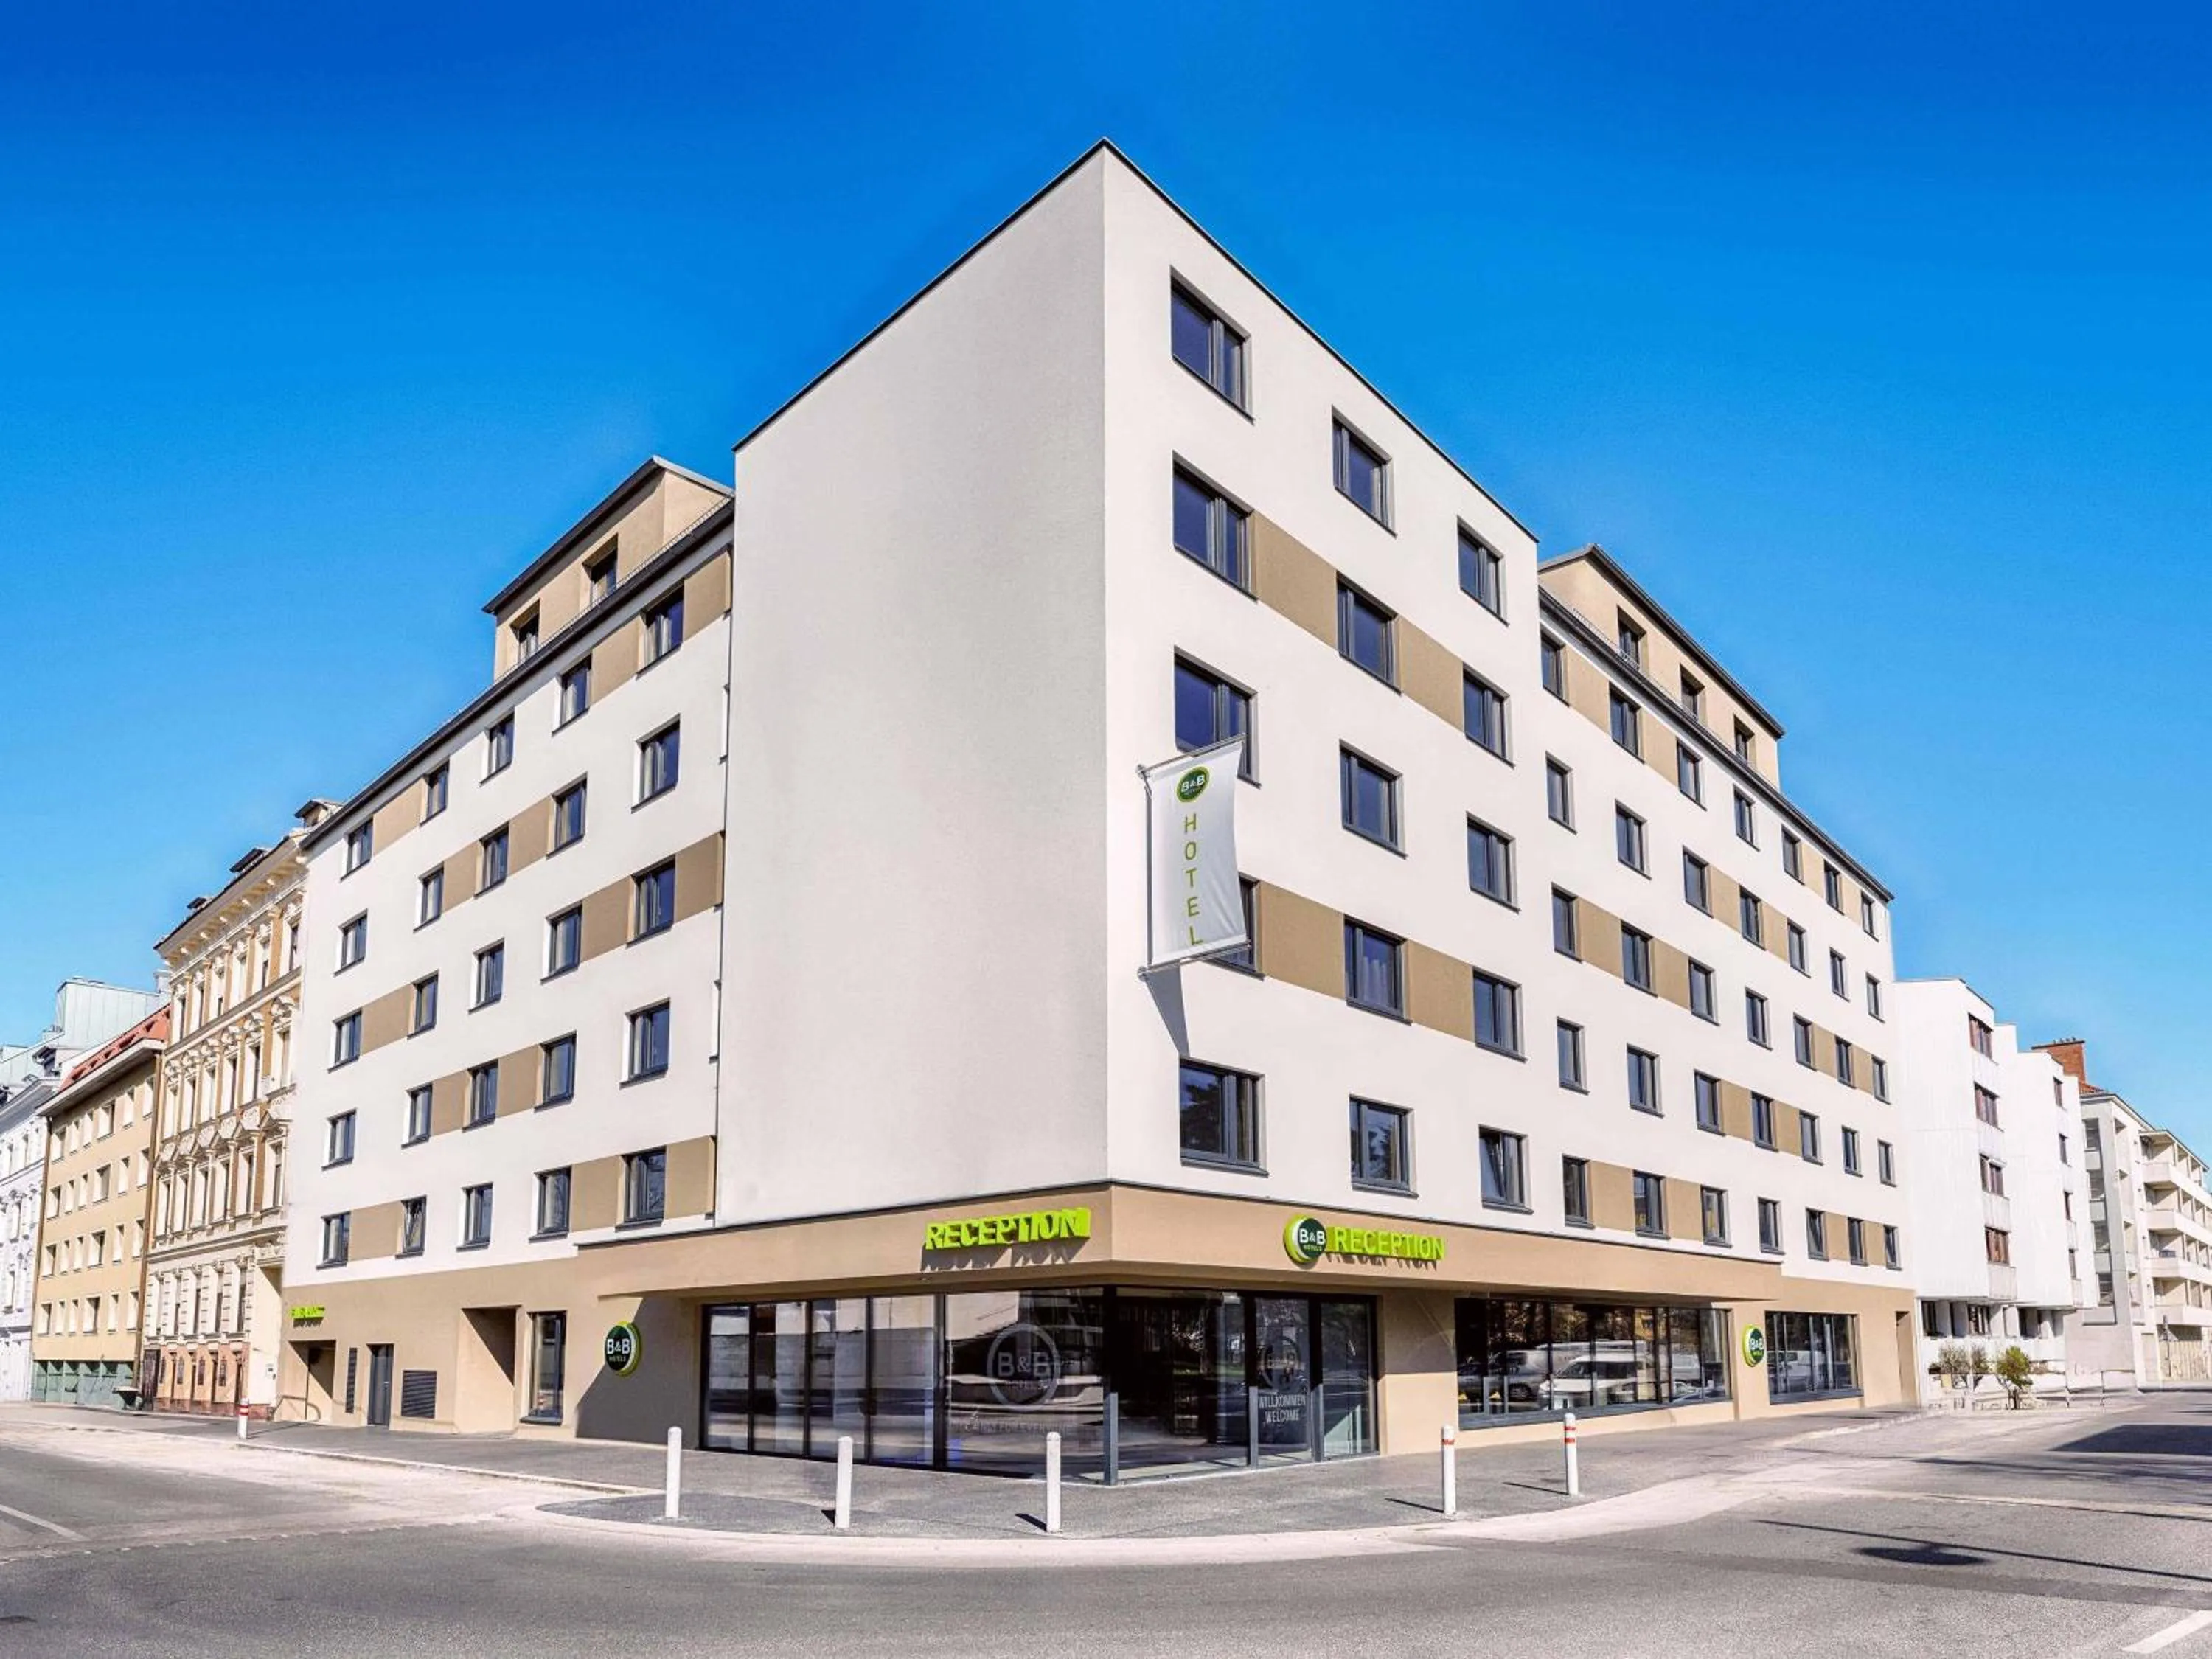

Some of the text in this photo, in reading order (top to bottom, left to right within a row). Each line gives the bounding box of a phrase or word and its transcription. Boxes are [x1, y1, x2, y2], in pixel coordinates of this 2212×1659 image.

[1184, 812, 1204, 946] HOTEL
[925, 1208, 1091, 1250] RECEPTION
[1299, 1228, 1325, 1245] B&B
[1333, 1226, 1444, 1260] RECEPTION
[607, 1338, 630, 1354] B&B
[998, 1352, 1051, 1377] B&B
[1265, 1409, 1300, 1424] WELCOME
